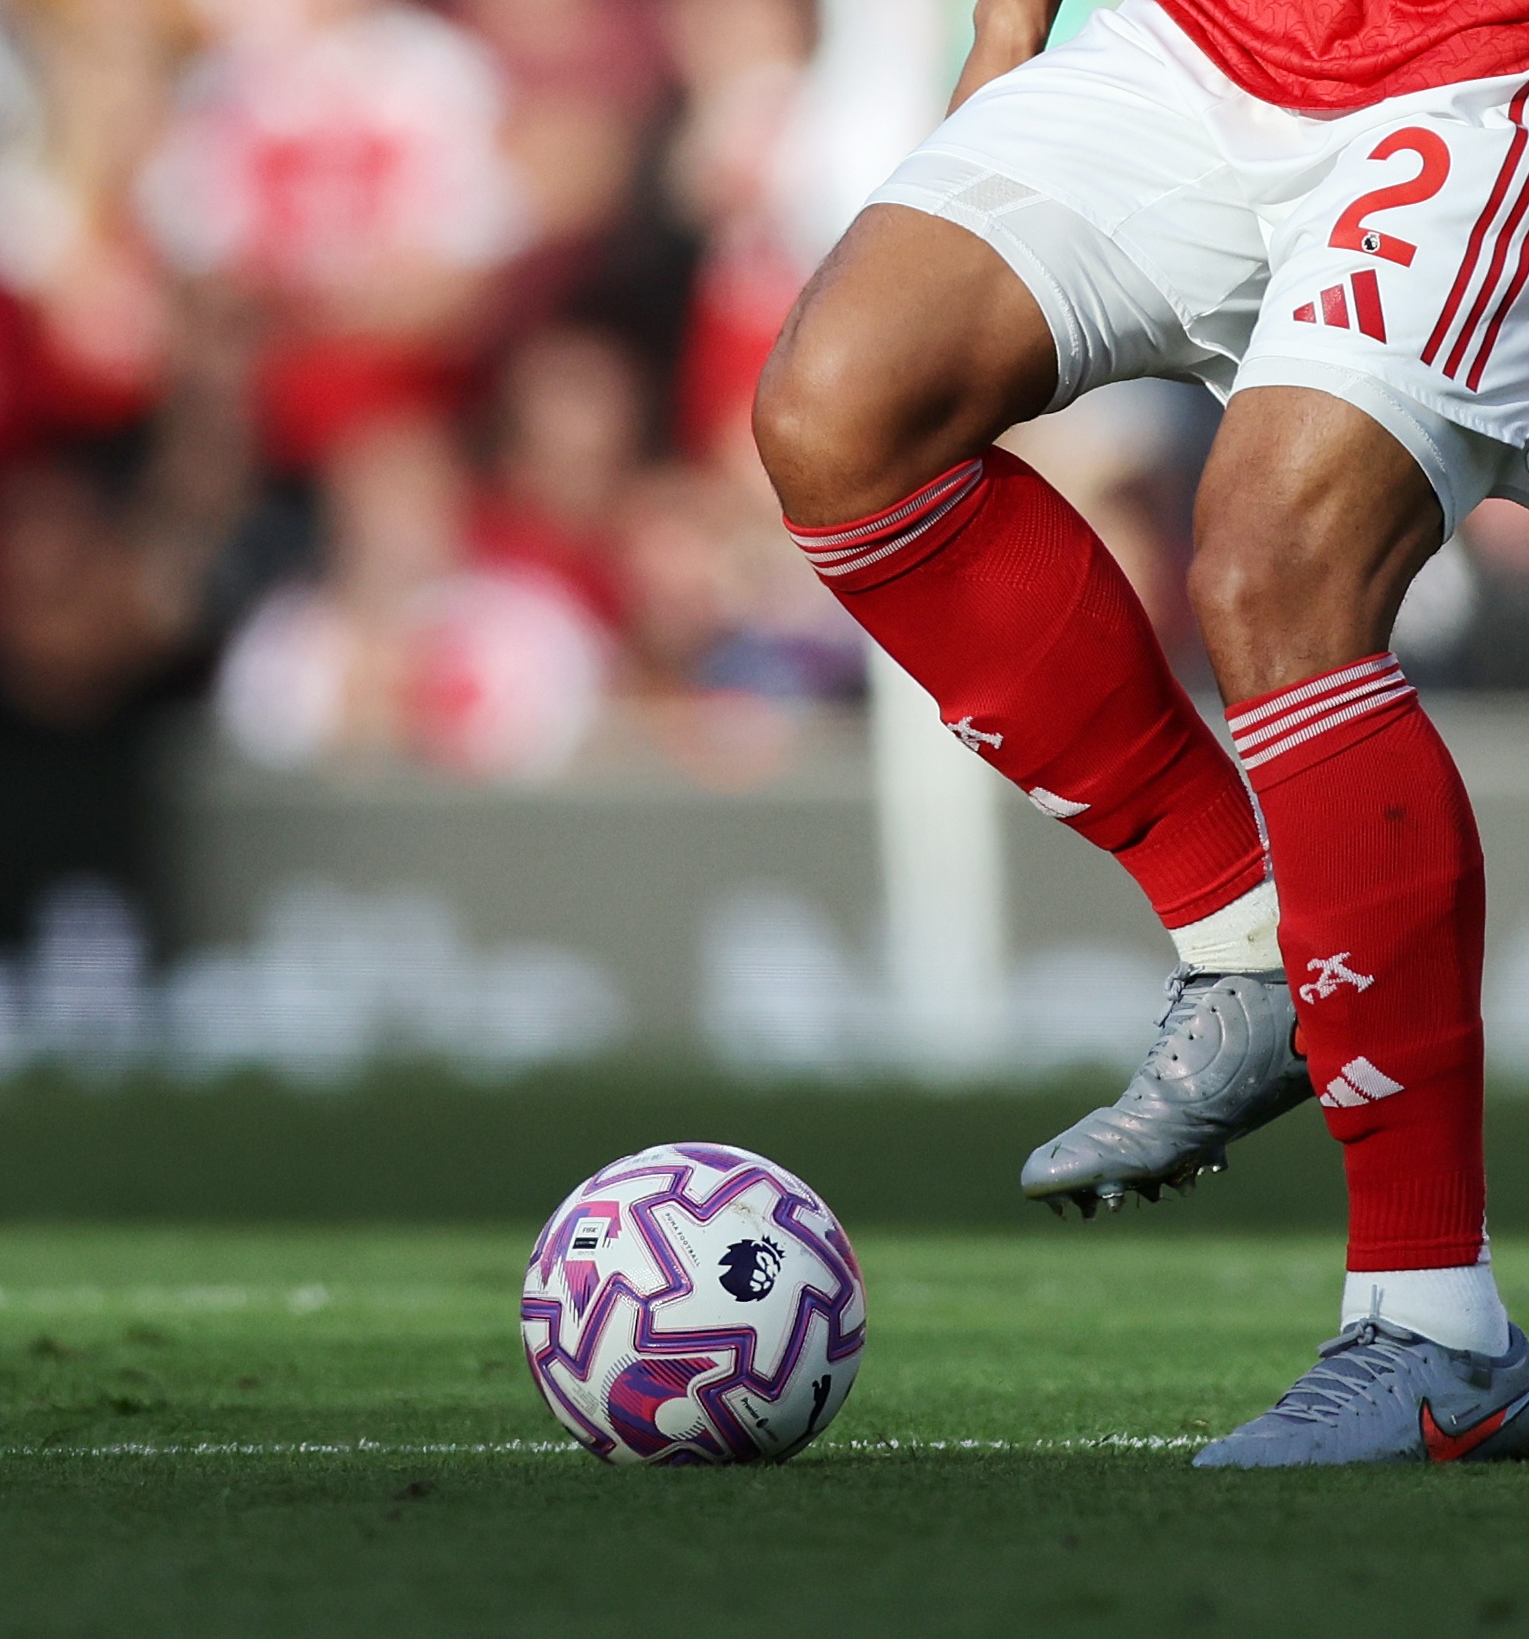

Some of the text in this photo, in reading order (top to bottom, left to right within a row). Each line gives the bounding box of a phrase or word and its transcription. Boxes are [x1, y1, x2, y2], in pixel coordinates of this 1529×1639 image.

[1328, 126, 1451, 268] 2
[665, 1212, 701, 1267] PUMA FOOTBALL
